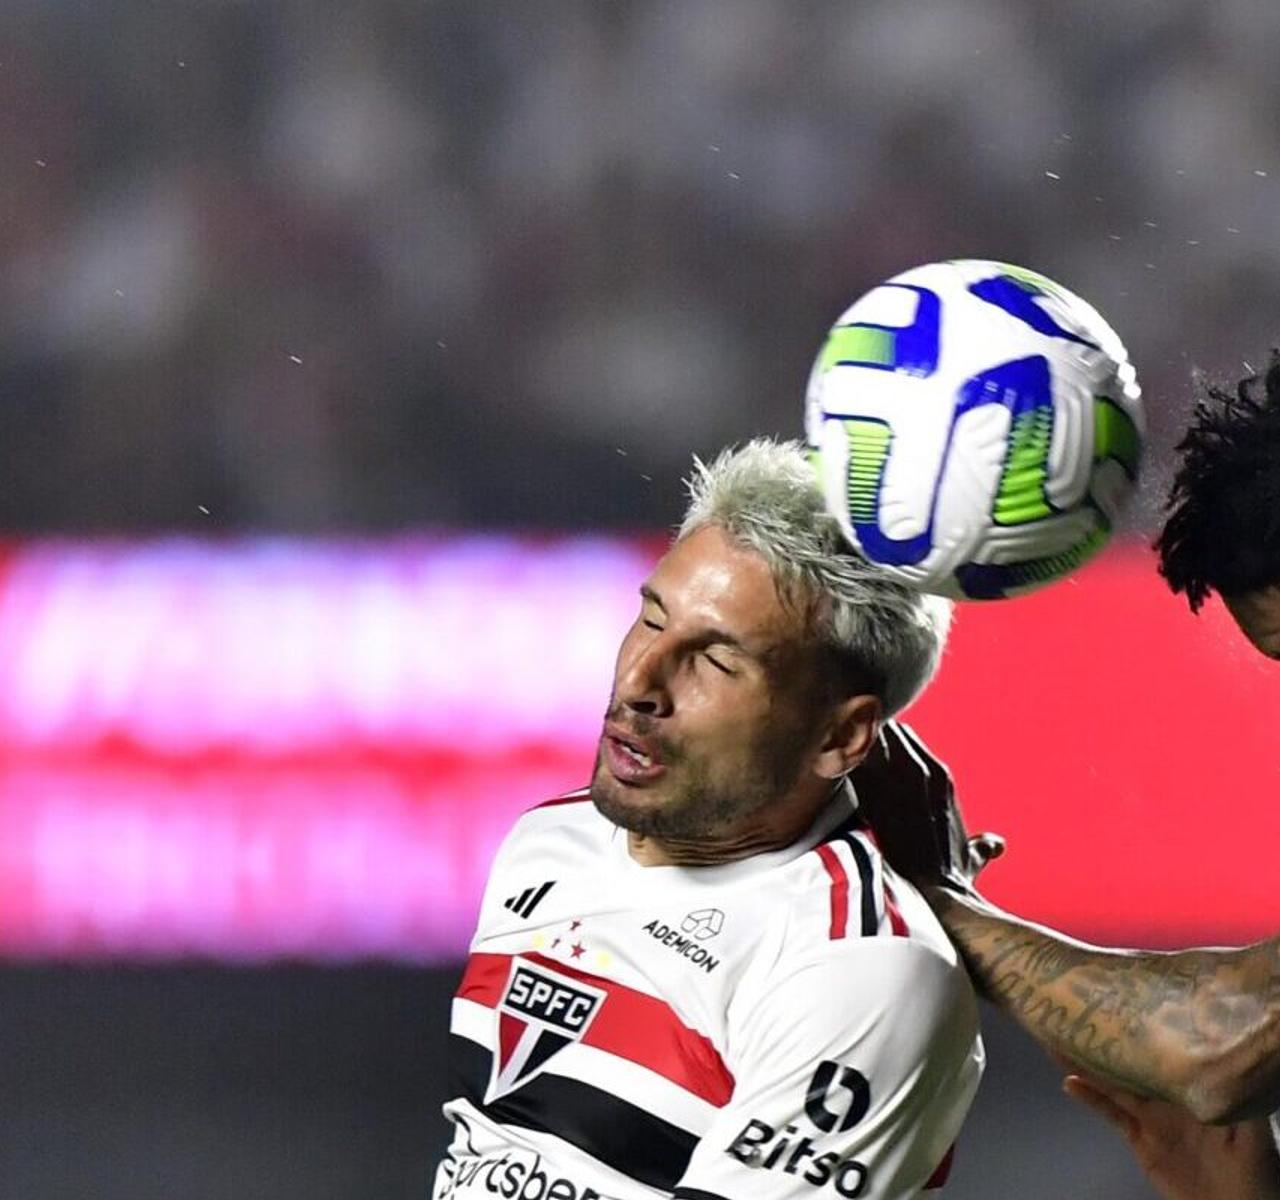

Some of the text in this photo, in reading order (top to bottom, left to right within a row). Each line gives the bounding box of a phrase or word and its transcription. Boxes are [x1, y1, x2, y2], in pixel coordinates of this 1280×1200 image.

[641, 919, 720, 973] ADEMICON
[508, 973, 592, 1027] SPFC
[723, 1118, 869, 1199] Bitso
